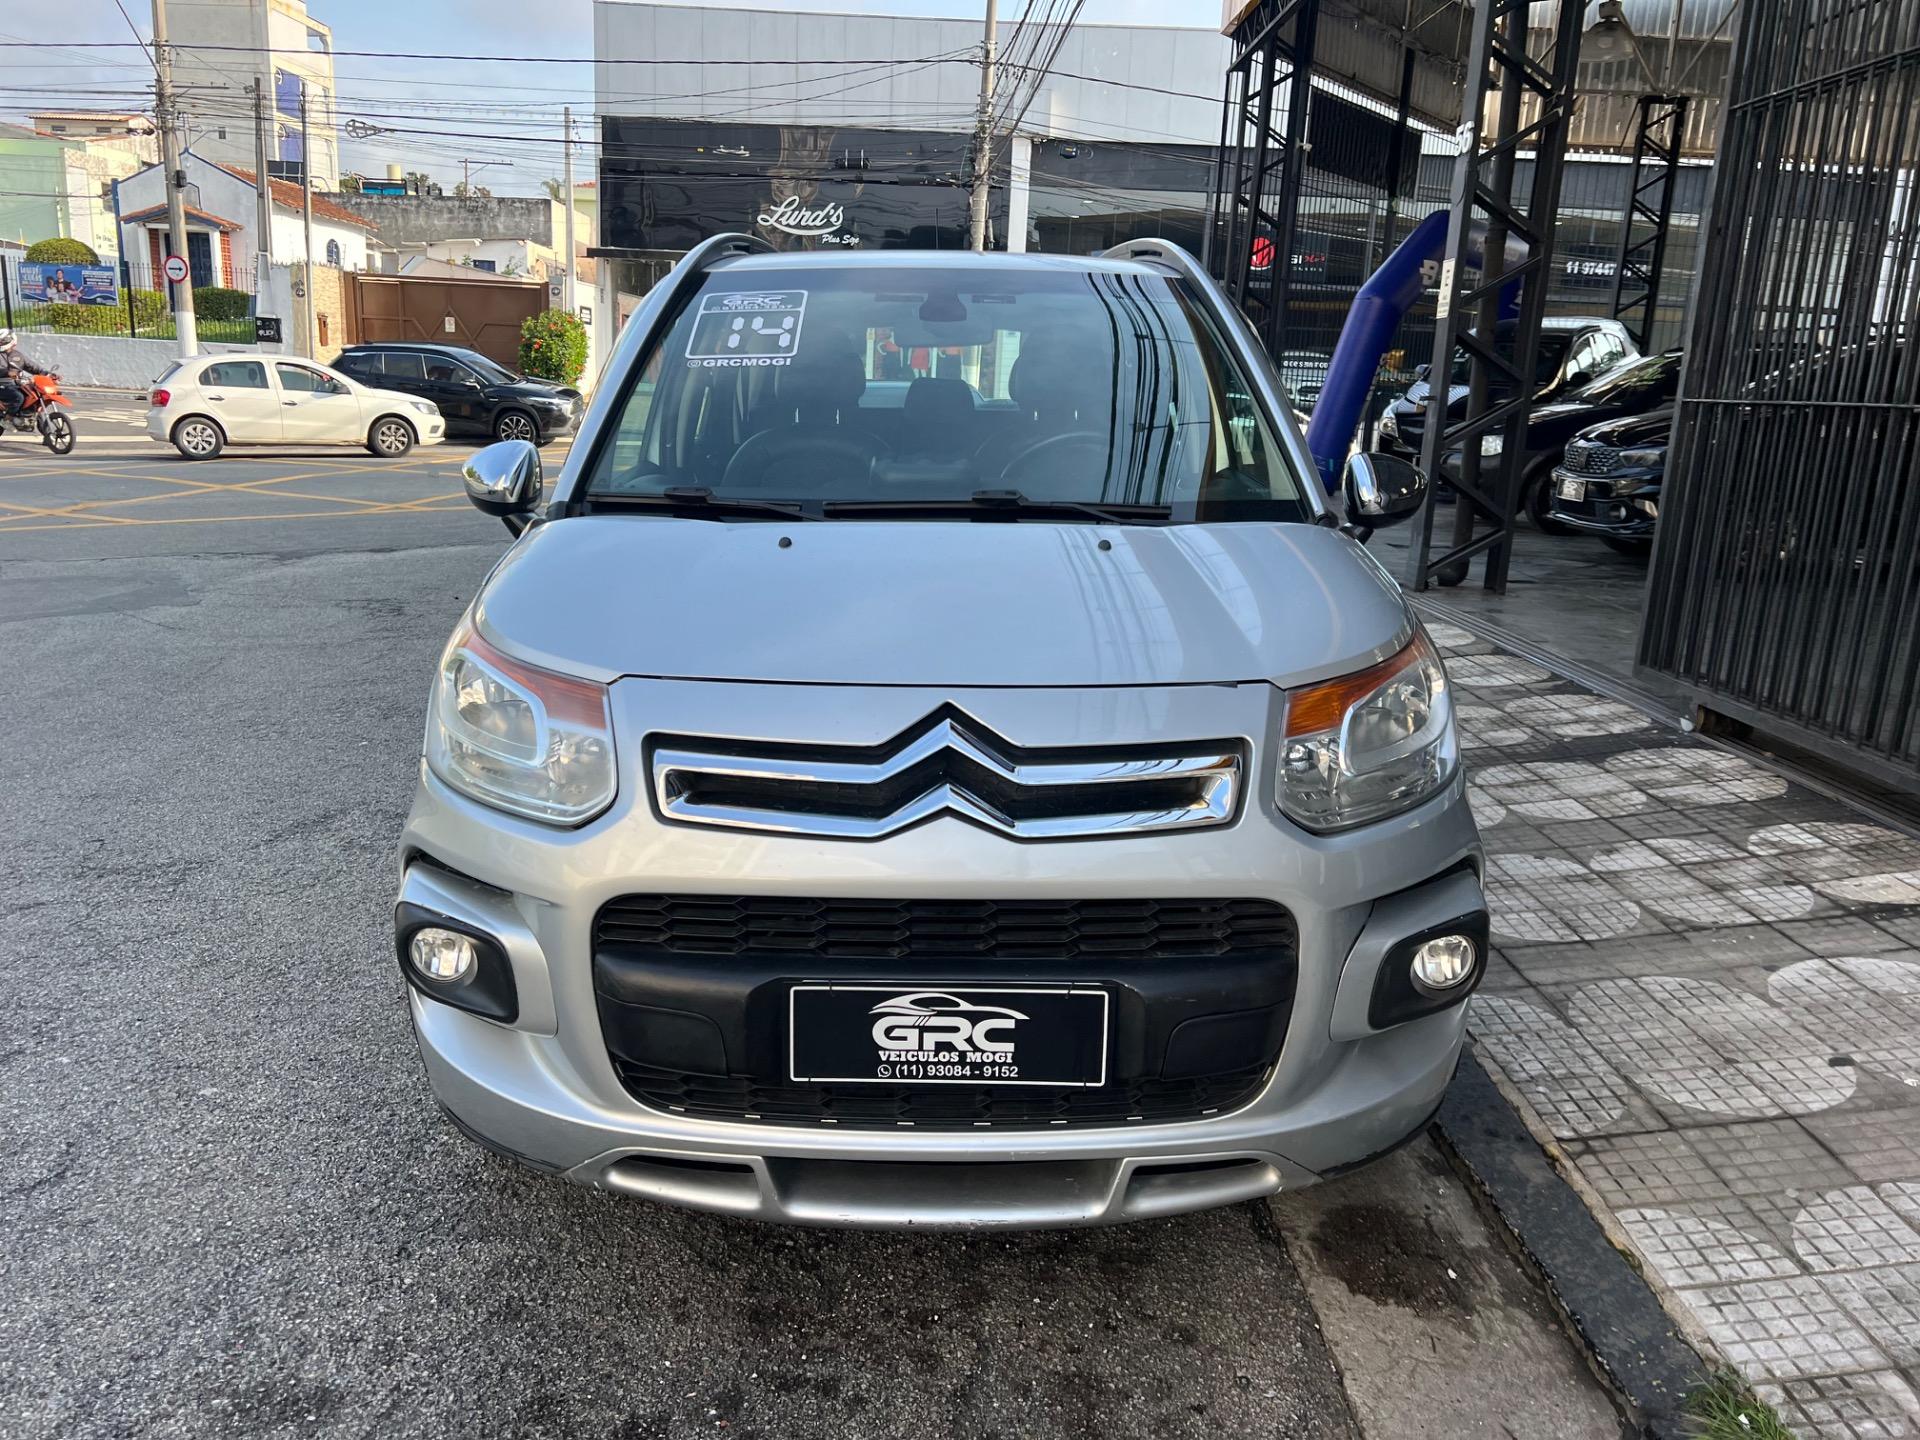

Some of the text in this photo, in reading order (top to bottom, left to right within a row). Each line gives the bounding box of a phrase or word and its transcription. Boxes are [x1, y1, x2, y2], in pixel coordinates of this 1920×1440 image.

[757, 195, 844, 236] Lurd's
[821, 234, 840, 244] Plus
[727, 316, 795, 349] 14
[686, 357, 792, 368] @GRCMOGI
[871, 1015, 1016, 1052] GRC
[878, 1050, 1014, 1063] VEICULOS MOGI
[895, 1064, 924, 1079] (11)
[926, 1064, 972, 1077] 93084
[982, 1066, 1019, 1078] 9152
